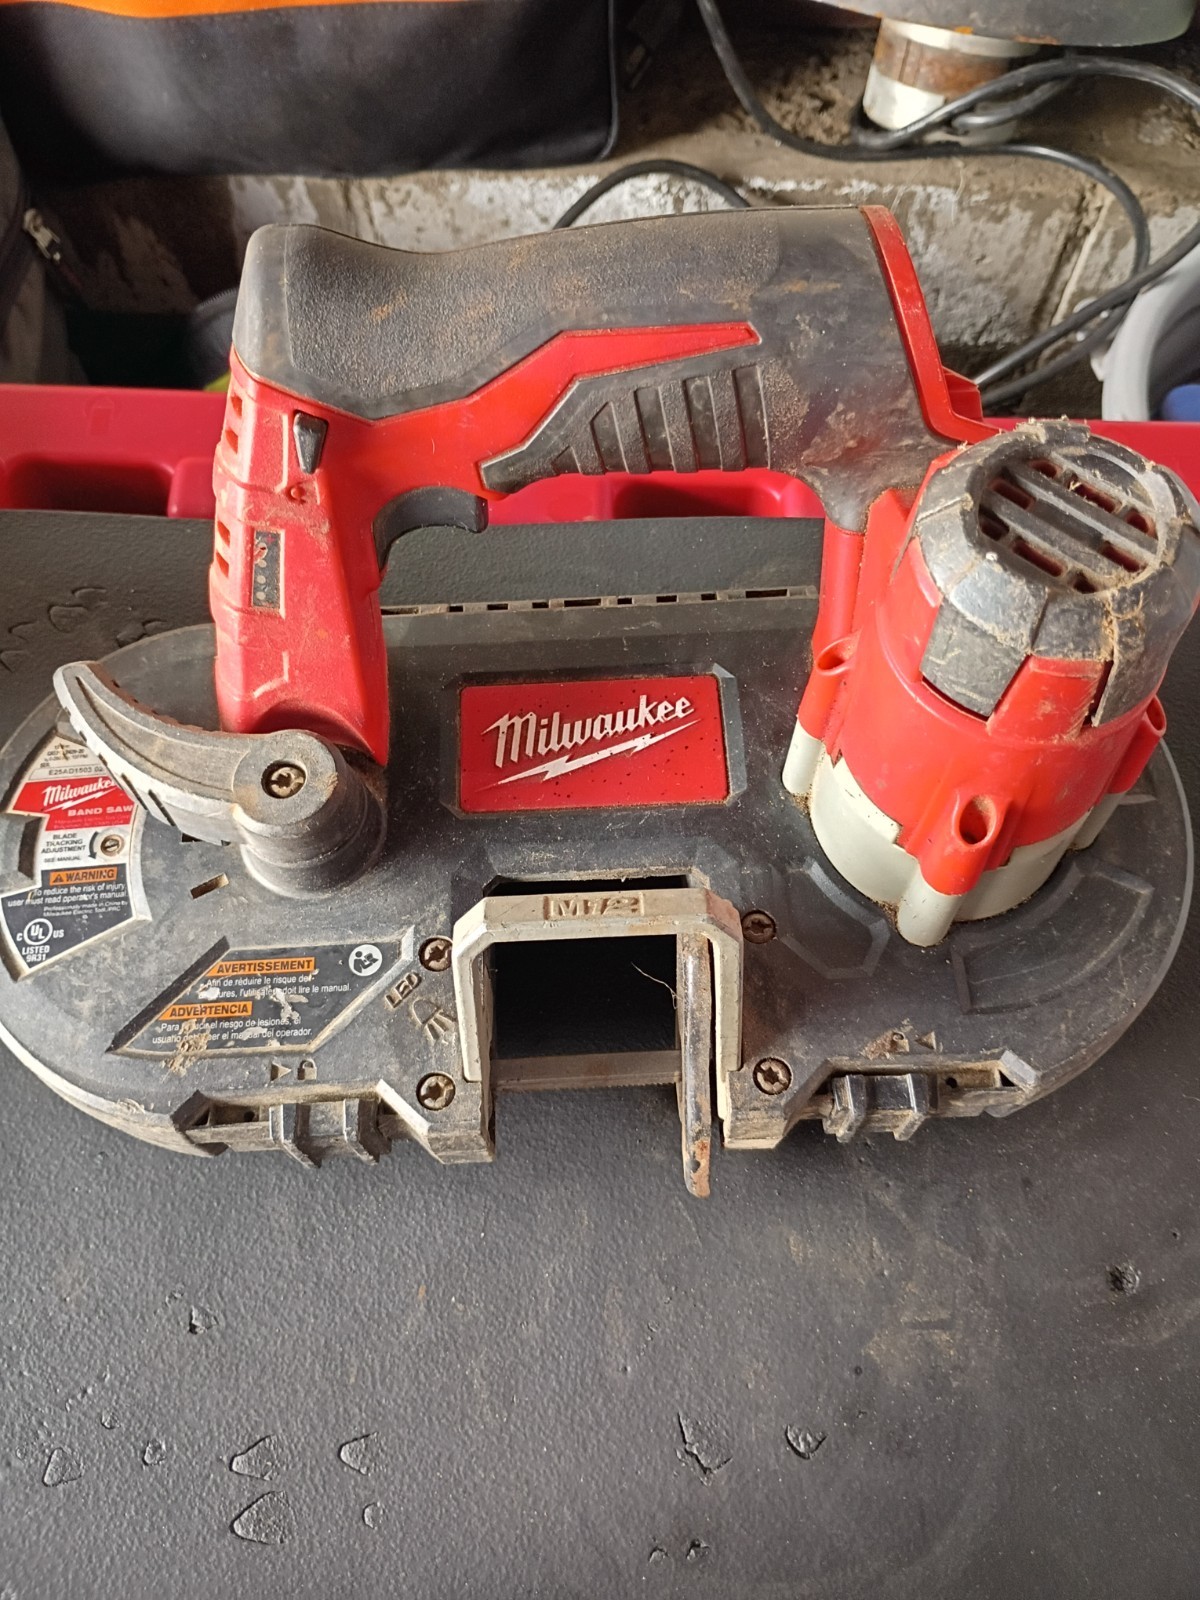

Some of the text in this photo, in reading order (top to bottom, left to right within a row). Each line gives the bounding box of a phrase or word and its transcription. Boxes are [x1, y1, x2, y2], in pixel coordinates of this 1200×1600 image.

[481, 695, 695, 768] Milwaukee
[68, 805, 133, 816] BAND SAW
[41, 845, 86, 854] ADJUSTMENT
[46, 839, 83, 847] TRACKING
[66, 869, 115, 882] WARNING
[43, 887, 68, 896] reduce
[83, 884, 95, 892] risk
[25, 897, 44, 905] must
[45, 895, 61, 903] read
[63, 892, 98, 902] operator's
[549, 896, 640, 917] M12
[30, 924, 45, 939] UL
[53, 929, 64, 938] US
[22, 945, 50, 955] LISTED
[217, 959, 313, 973] AVERTISSEMENT
[206, 978, 221, 987] Afin
[223, 977, 233, 986] de
[235, 976, 262, 986] réduire
[264, 976, 271, 984] le
[273, 975, 297, 986] risque
[283, 985, 297, 994] doit
[299, 985, 311, 993] lire
[312, 984, 319, 992] le
[321, 983, 352, 993] manual.
[384, 971, 422, 1009] LED
[170, 1004, 248, 1018] ADVERTENCIA
[161, 1022, 180, 1032] Para
[219, 1020, 243, 1030] riesgo
[245, 1019, 256, 1027] de
[257, 1018, 292, 1028] lesiones,
[294, 1017, 302, 1025] el
[152, 1035, 181, 1044] usuario
[222, 1032, 230, 1040] el
[275, 1027, 313, 1038] operador.
